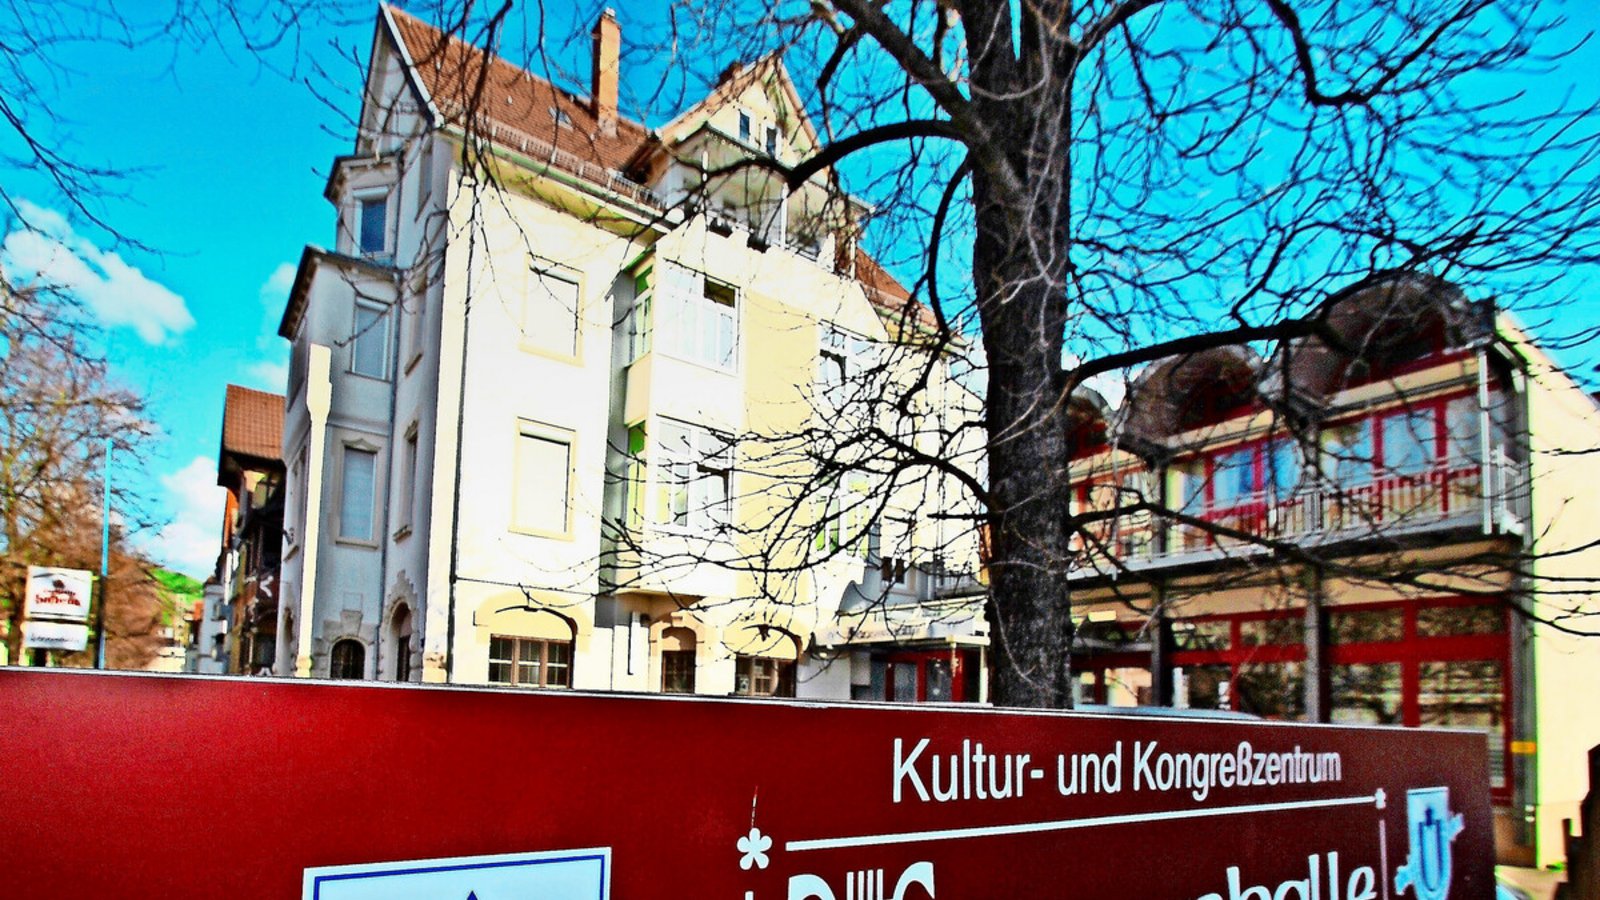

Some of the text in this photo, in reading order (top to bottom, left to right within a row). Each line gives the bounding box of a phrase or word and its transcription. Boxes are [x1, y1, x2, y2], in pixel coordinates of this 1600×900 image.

[893, 738, 1342, 803] Kultur- und Kongreßzentrum
